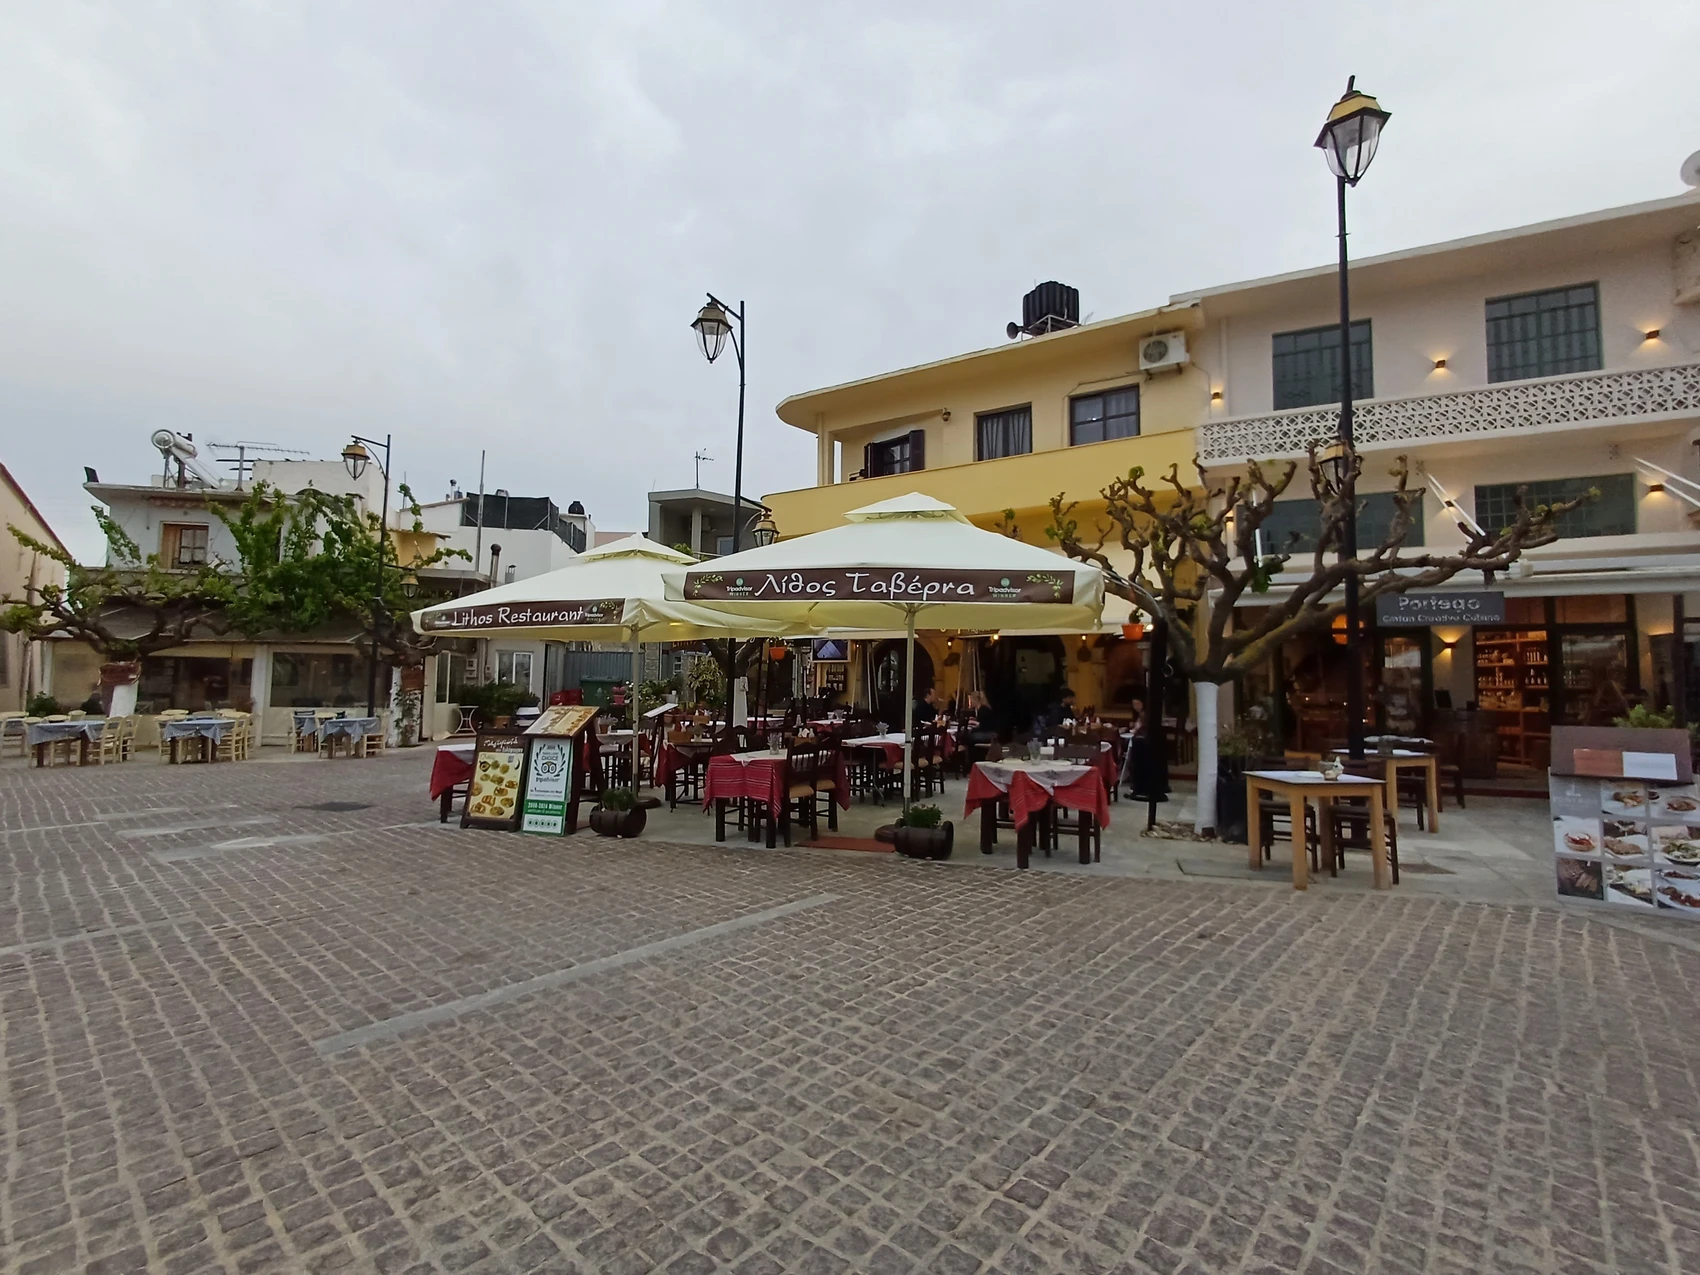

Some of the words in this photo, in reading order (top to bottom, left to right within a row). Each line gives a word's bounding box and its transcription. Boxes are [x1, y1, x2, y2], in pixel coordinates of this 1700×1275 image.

[754, 572, 836, 597] Λίθος
[451, 608, 493, 626] Lithos
[497, 606, 584, 624] Restaurant
